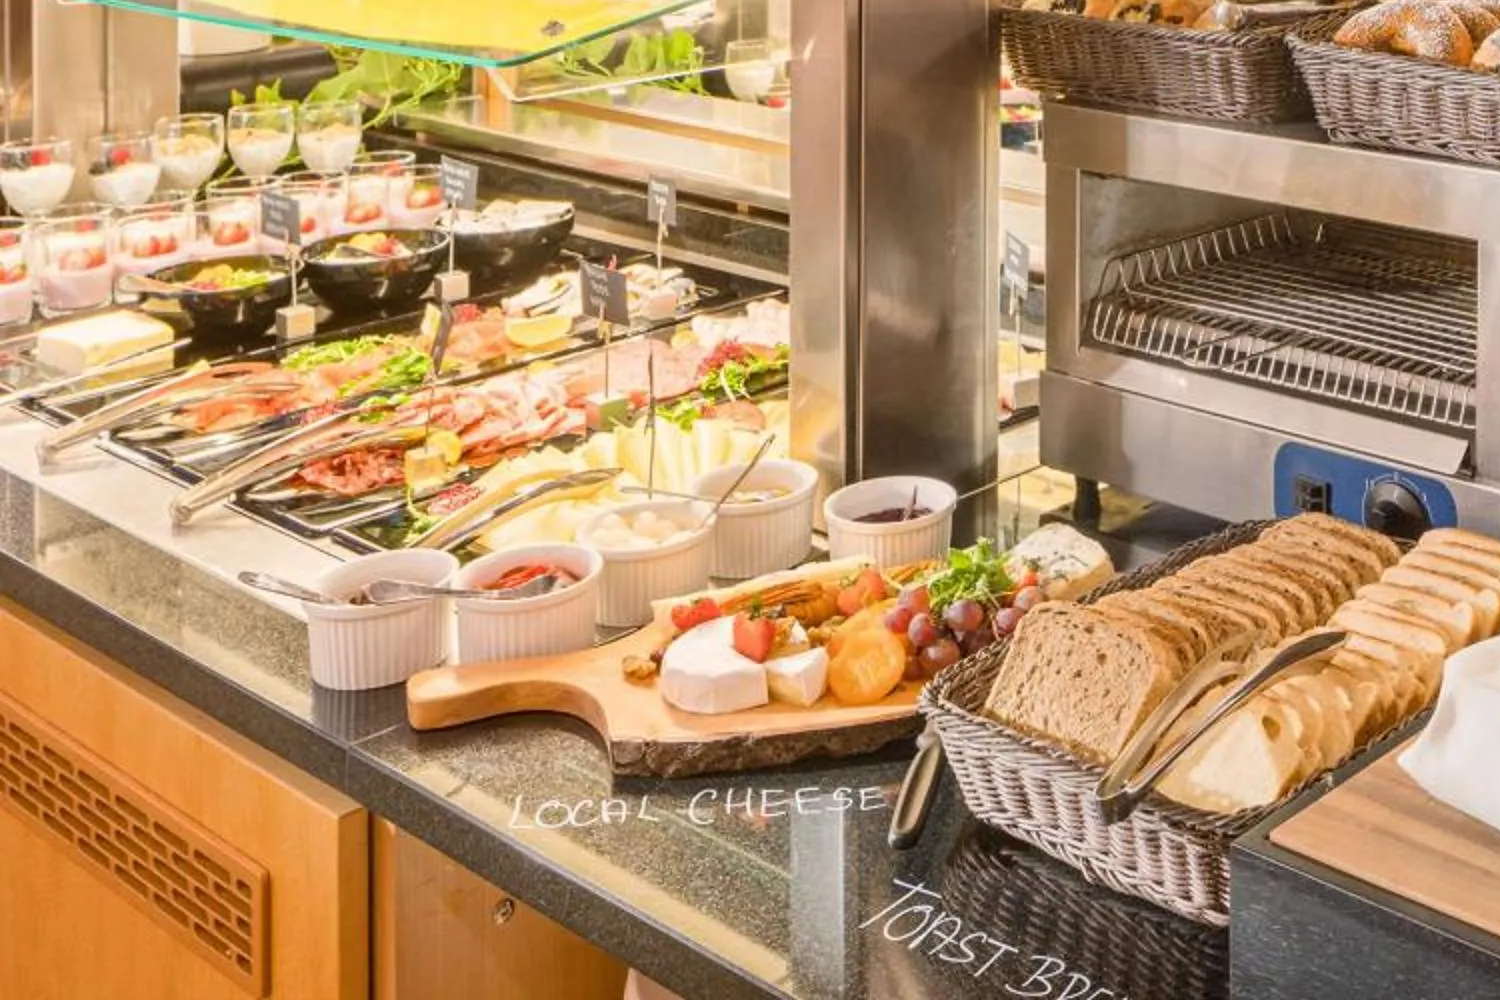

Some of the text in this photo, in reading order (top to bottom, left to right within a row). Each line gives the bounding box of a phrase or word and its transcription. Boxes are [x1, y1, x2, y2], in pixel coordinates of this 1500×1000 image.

[509, 784, 889, 831] LOCAL CHEESE
[858, 877, 1019, 977] TOAST
